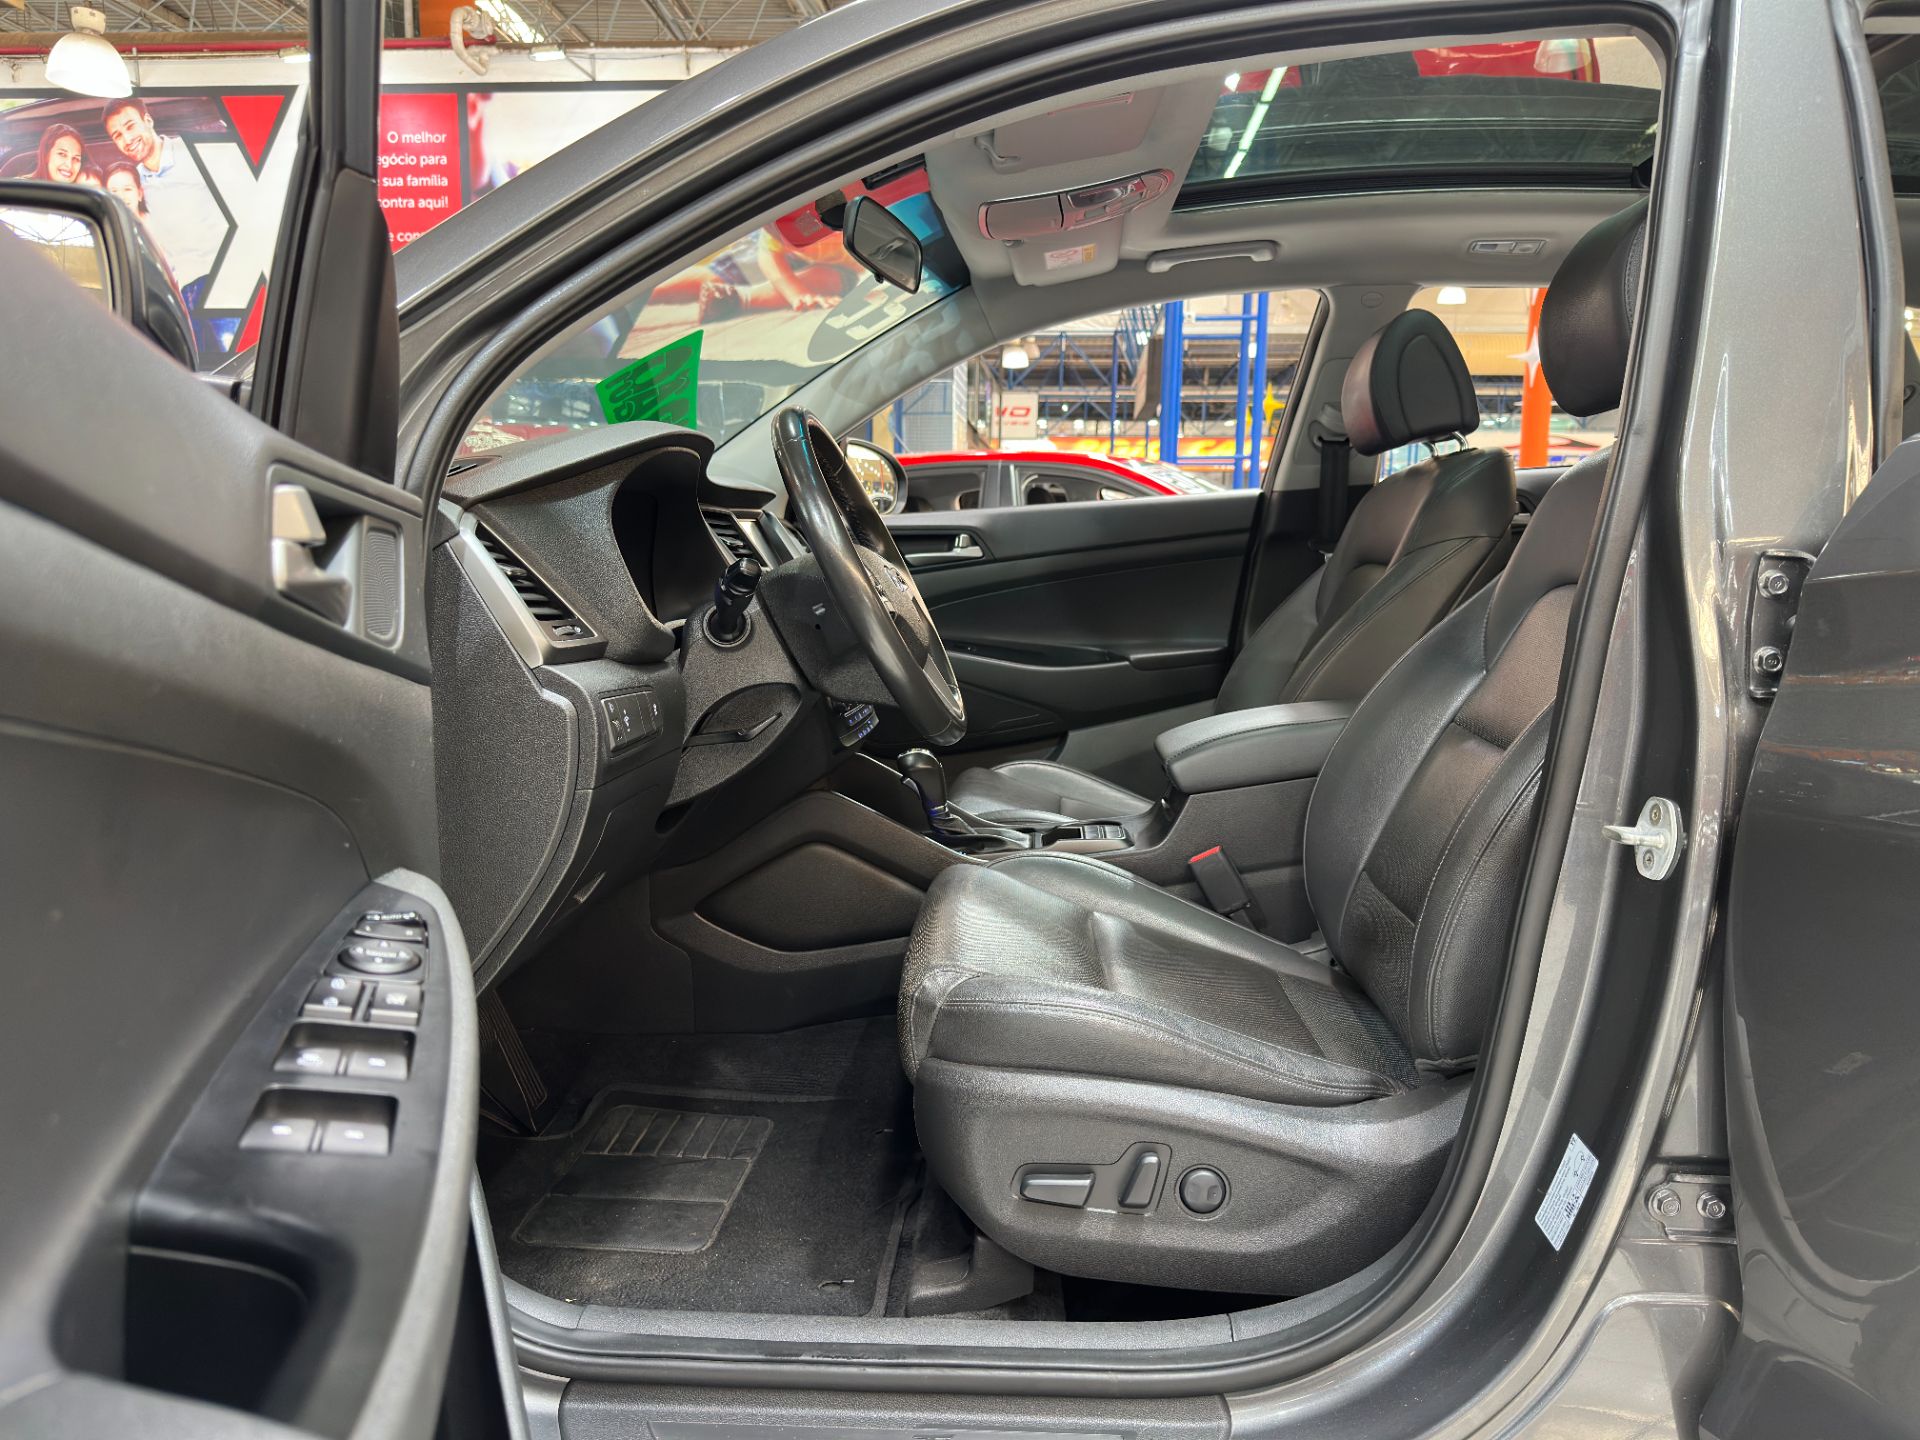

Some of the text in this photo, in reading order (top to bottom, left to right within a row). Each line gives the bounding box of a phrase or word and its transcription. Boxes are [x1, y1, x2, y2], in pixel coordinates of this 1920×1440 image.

[387, 131, 447, 143] O melhor
[419, 155, 447, 167] para
[382, 174, 448, 187] sua família
[418, 197, 449, 210] aqui!
